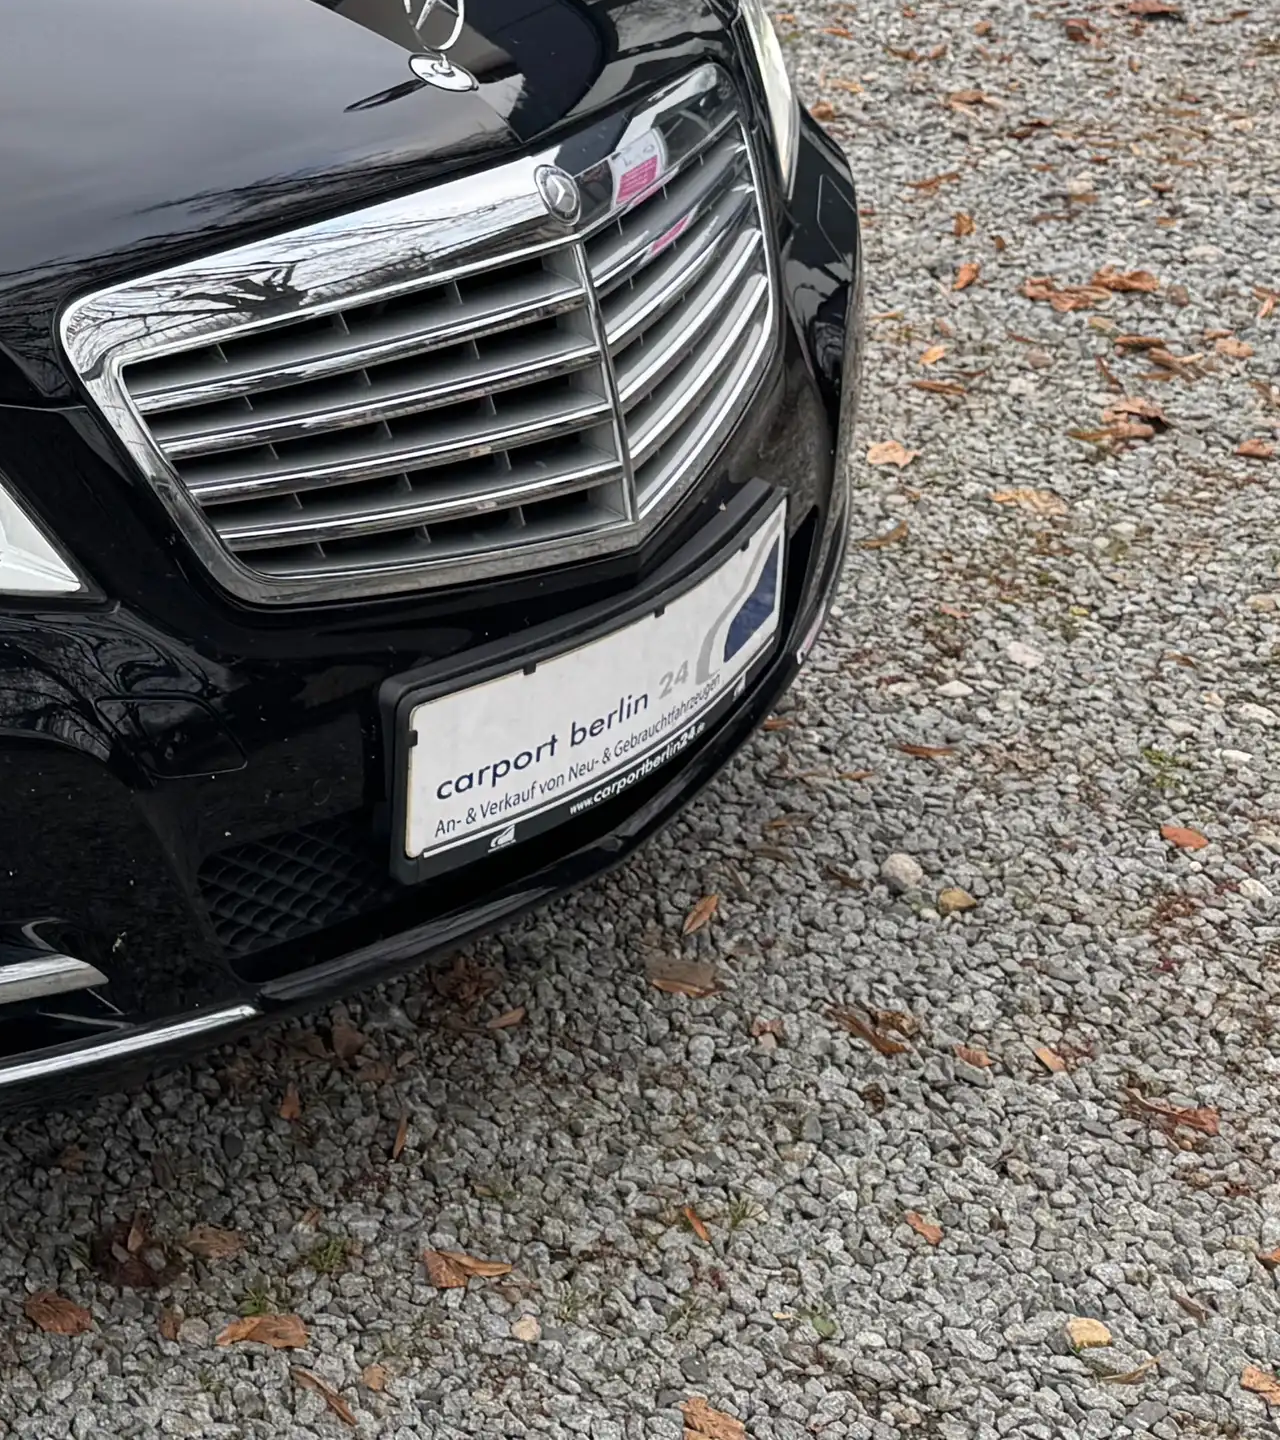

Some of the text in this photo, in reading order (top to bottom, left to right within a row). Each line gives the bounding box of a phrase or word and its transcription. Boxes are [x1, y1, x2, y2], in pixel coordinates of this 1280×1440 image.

[435, 673, 721, 839] An- & Verkauf von Neu- & Gebrauchtfahrzeugen
[436, 661, 688, 801] carport berlin 24
